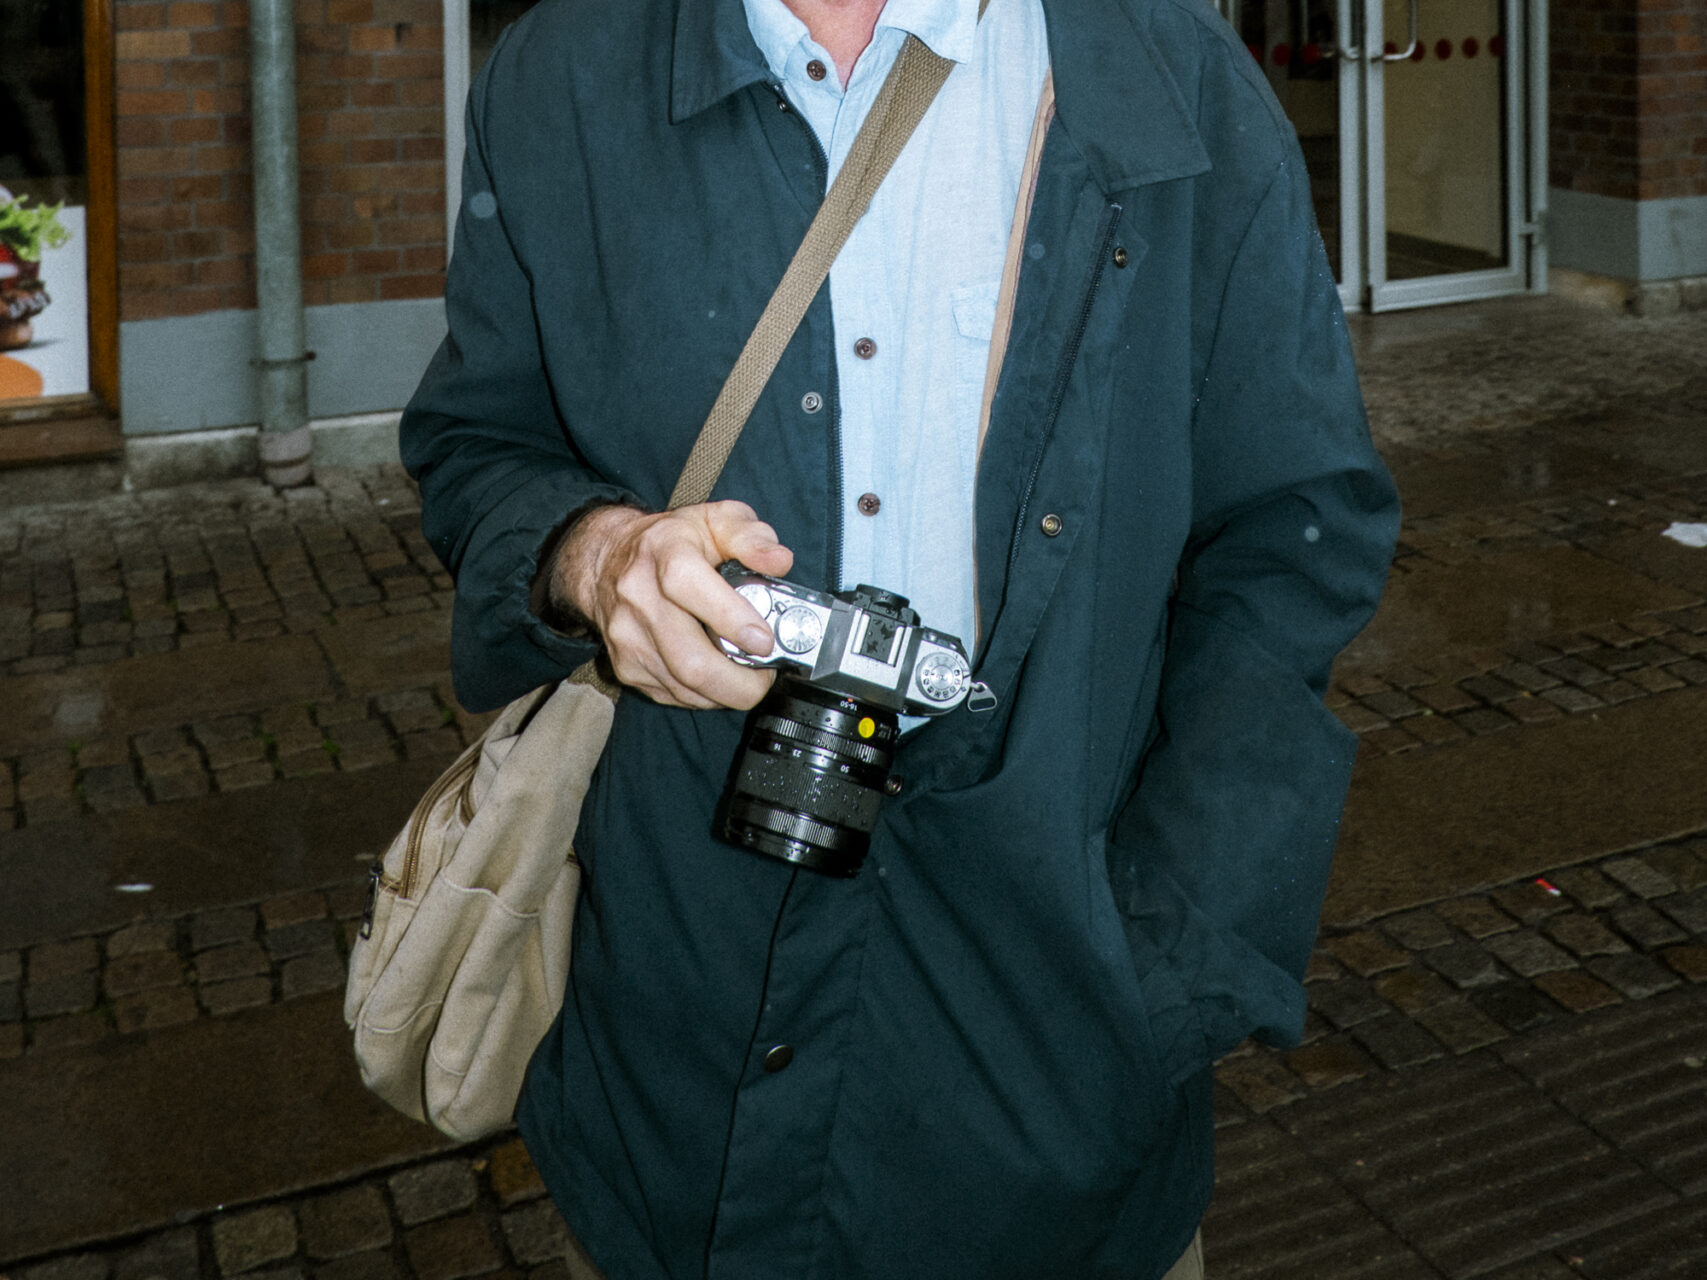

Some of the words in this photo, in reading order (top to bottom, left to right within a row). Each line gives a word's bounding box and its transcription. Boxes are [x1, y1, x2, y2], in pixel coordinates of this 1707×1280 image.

[840, 700, 858, 711] 16-50
[773, 742, 782, 751] 16
[792, 748, 802, 758] 23
[840, 764, 850, 774] 50
